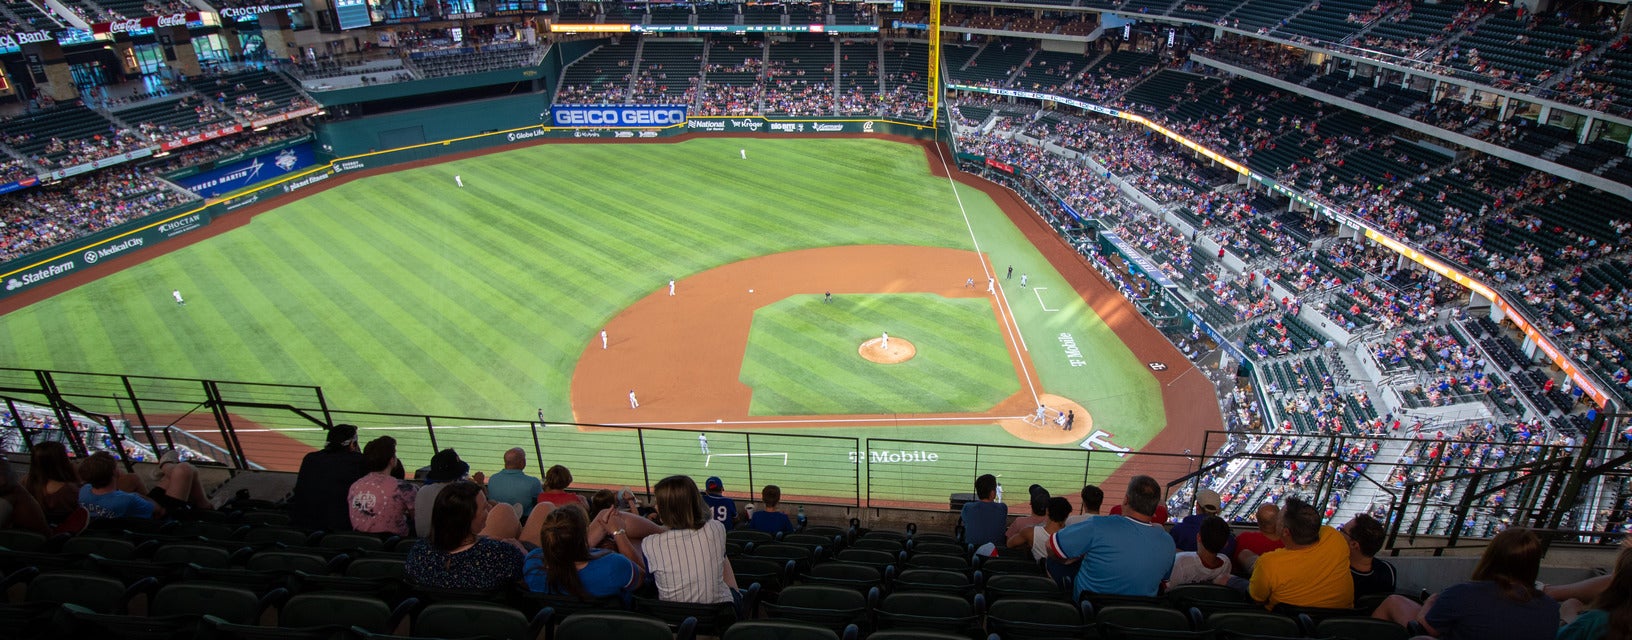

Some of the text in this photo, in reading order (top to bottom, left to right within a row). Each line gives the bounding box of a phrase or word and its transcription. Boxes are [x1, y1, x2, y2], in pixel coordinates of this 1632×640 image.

[226, 4, 270, 18] CHOCTAW
[16, 29, 54, 45] Bank
[555, 110, 684, 124] GEICO GEICO
[696, 119, 726, 129] National
[741, 118, 764, 131] Kroger
[516, 130, 545, 140] Globe Life
[219, 171, 247, 184] MARTIN
[290, 173, 329, 191] planet fitness
[162, 214, 200, 232] CHOCTAW
[98, 237, 144, 258] Medical City
[870, 450, 938, 463] Mobile
[709, 505, 727, 521] 19
